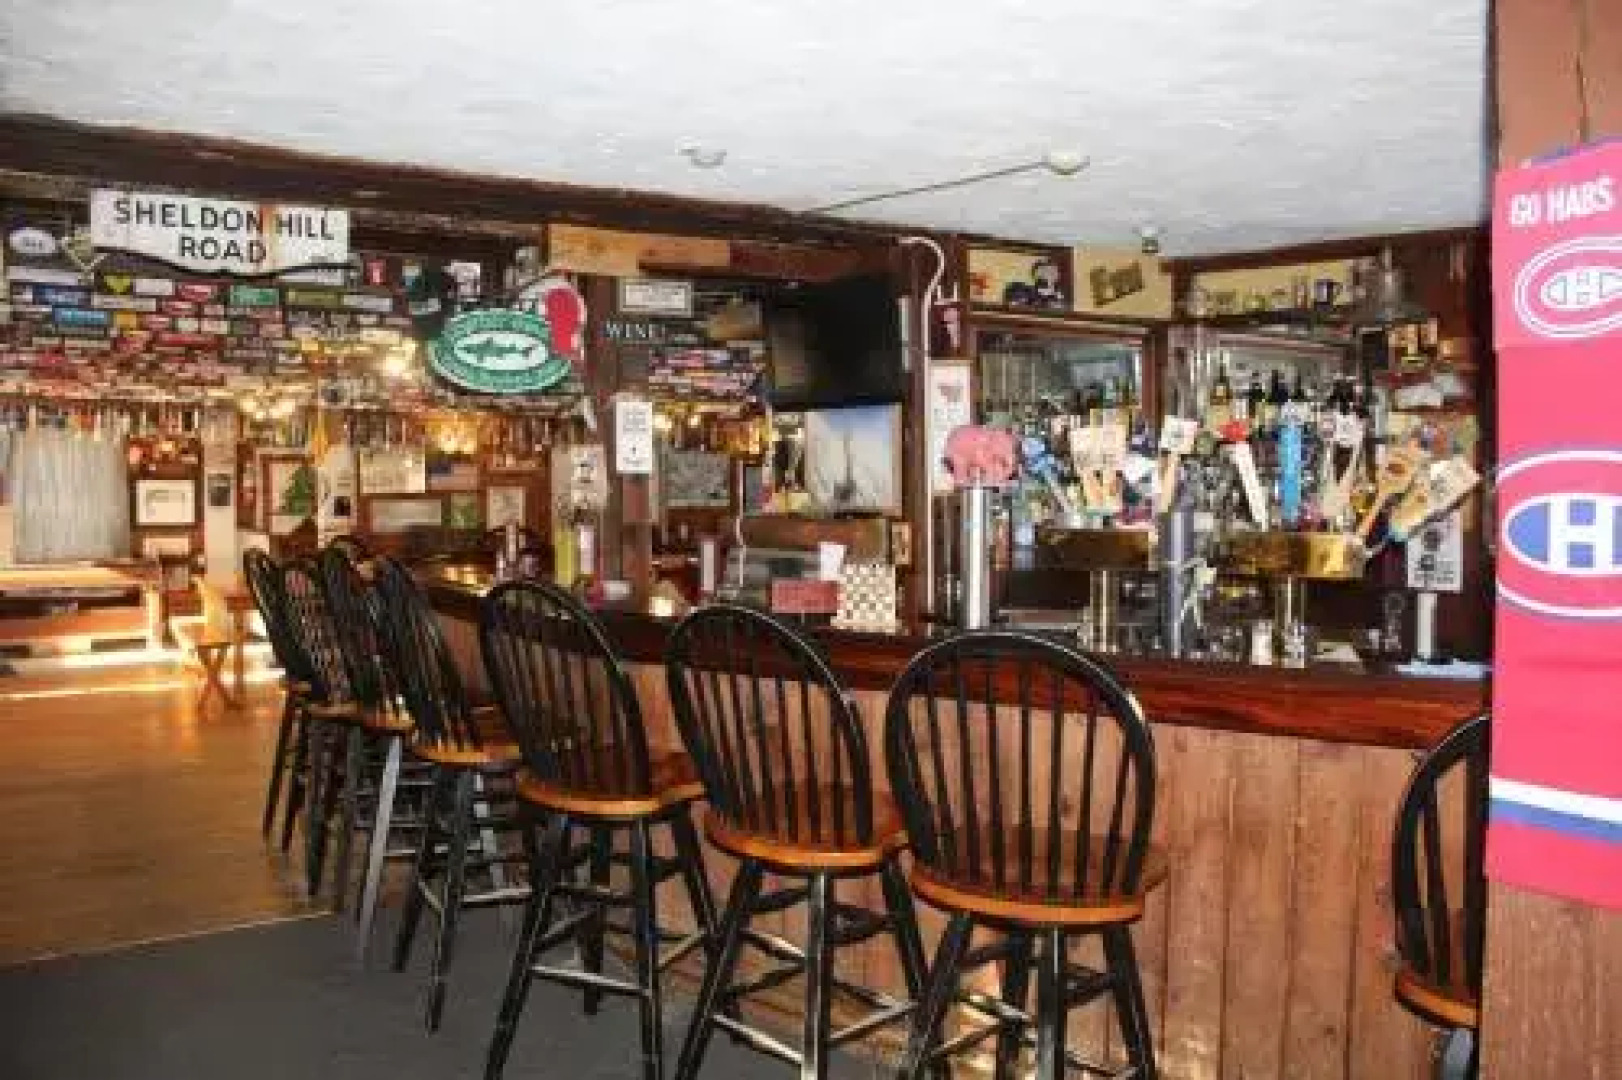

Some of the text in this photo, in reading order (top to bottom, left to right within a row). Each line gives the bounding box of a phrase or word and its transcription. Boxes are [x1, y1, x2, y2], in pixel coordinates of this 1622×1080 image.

[115, 198, 335, 240] SHELDON HILL
[1510, 174, 1616, 227] GO HABS
[180, 236, 267, 263] ROAD
